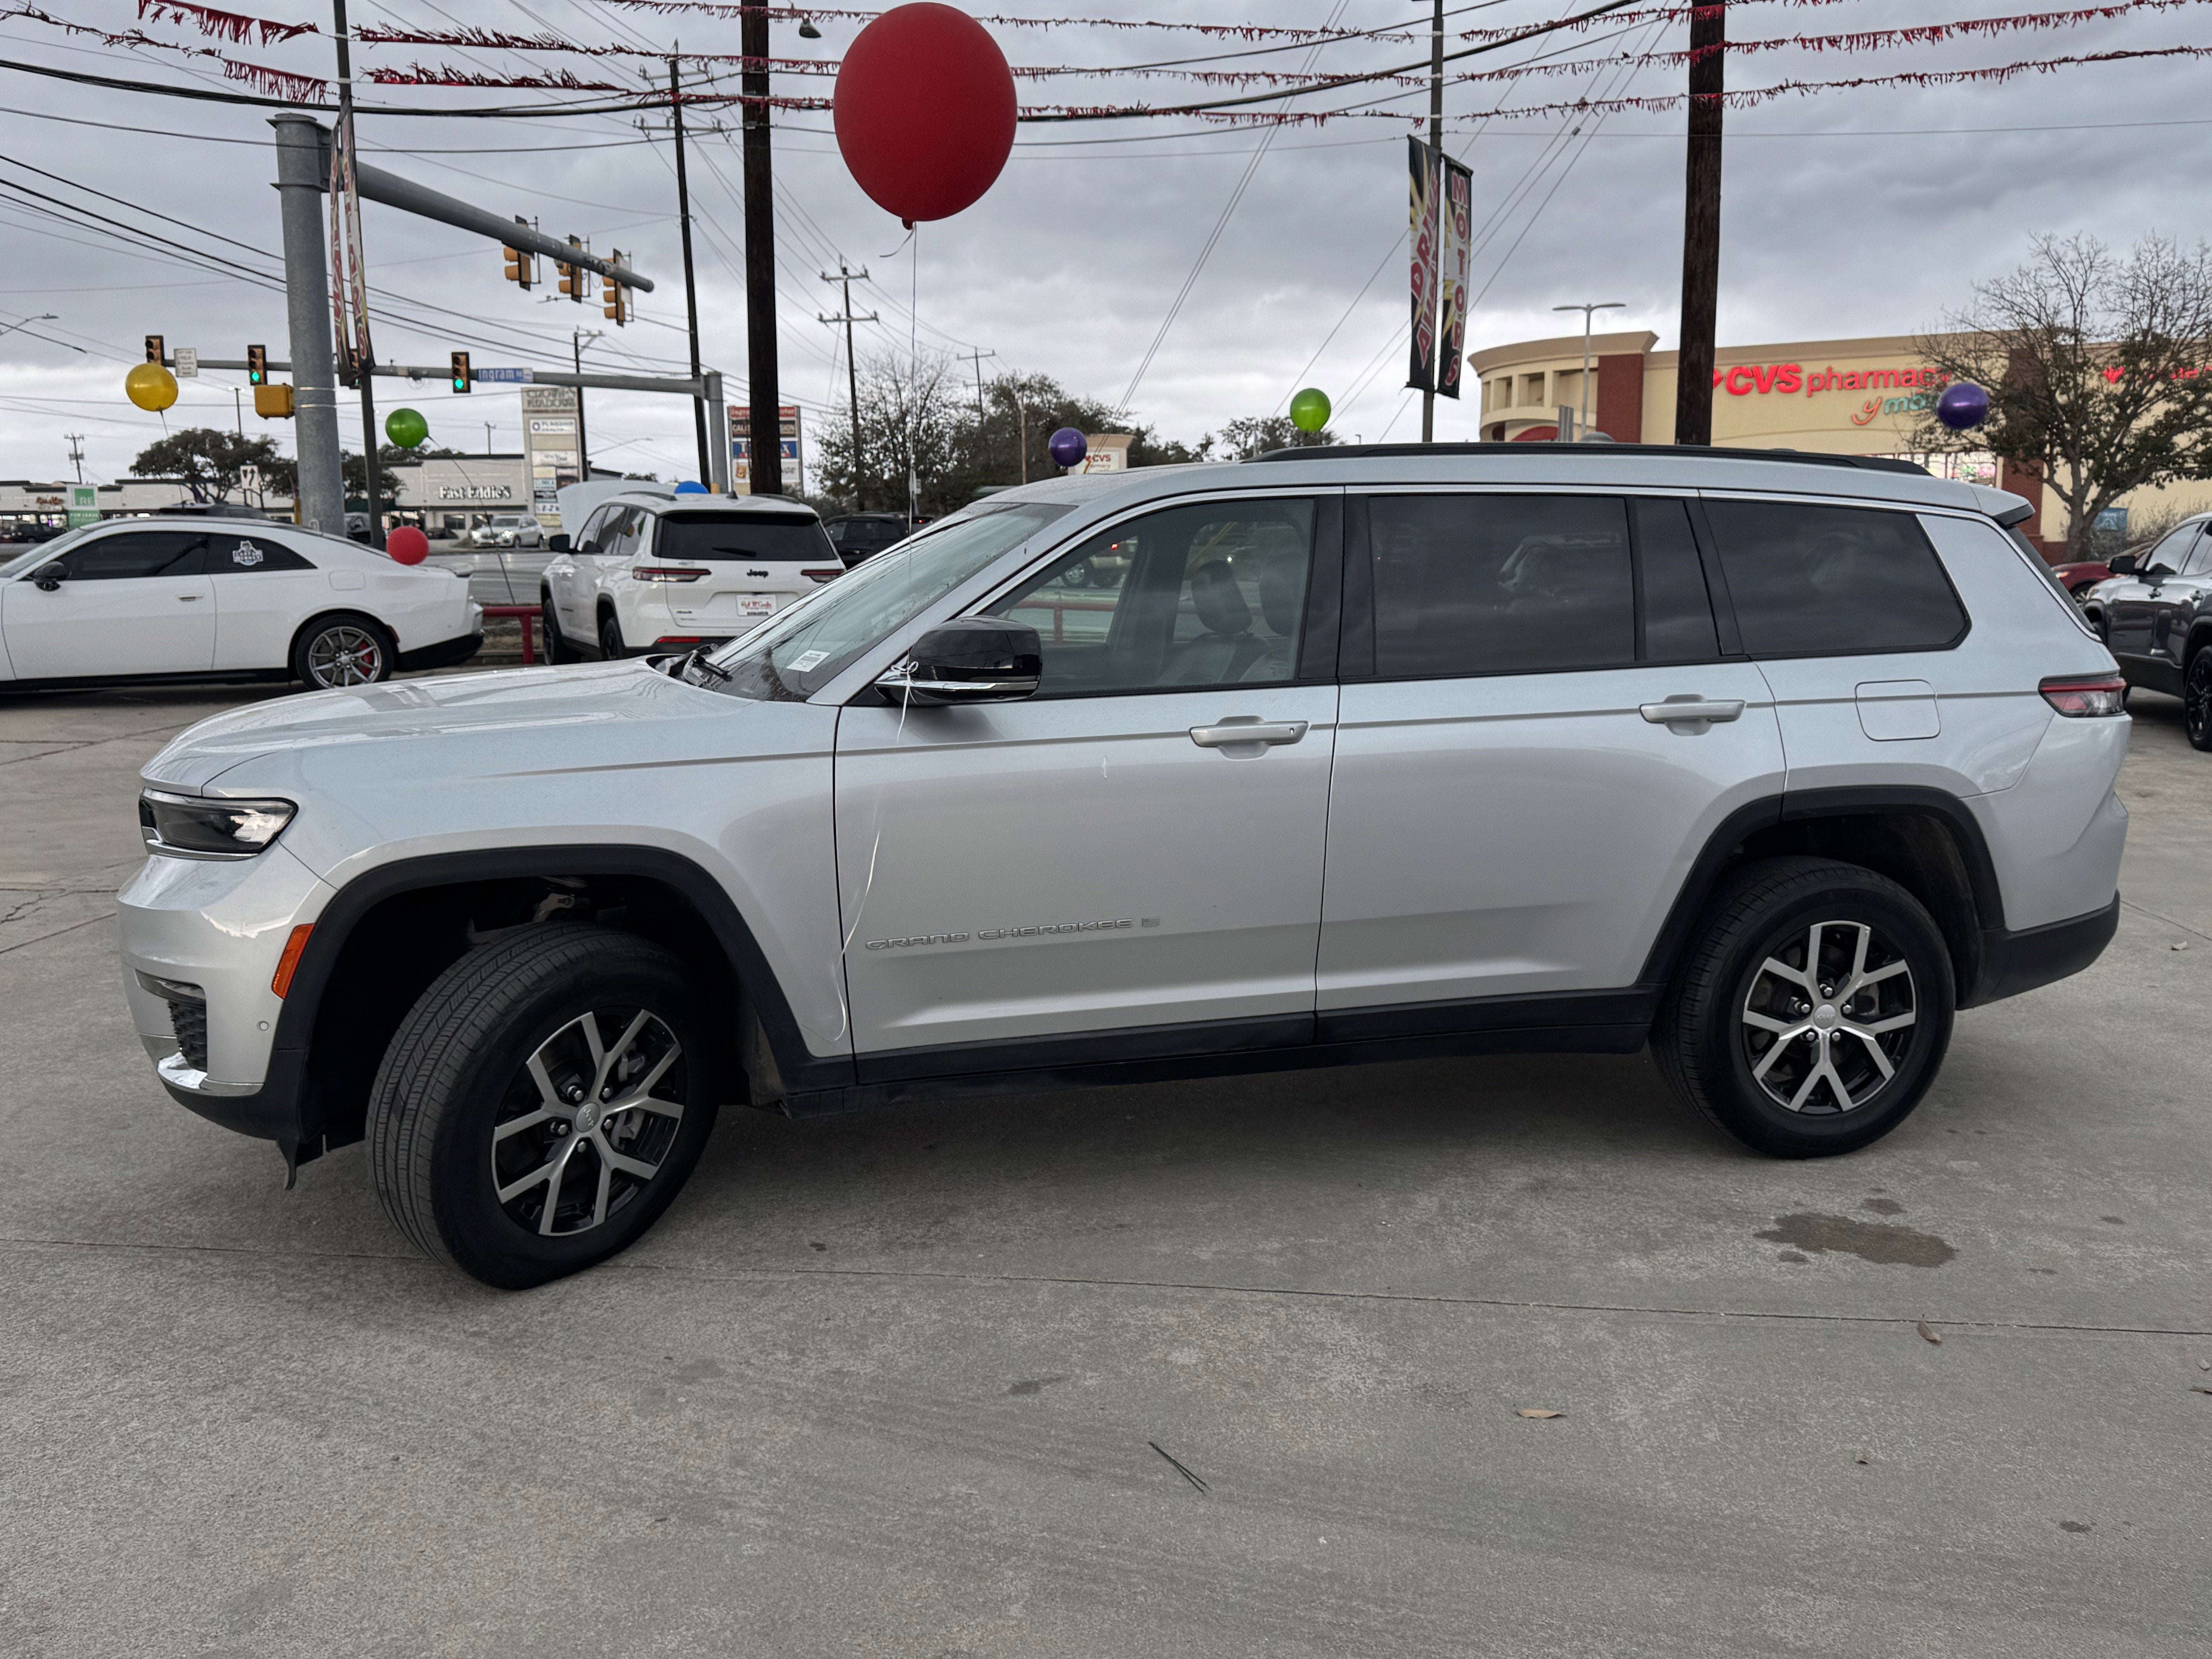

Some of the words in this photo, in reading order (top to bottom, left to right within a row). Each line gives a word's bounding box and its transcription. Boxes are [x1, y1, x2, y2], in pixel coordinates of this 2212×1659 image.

[1445, 172, 1467, 386] MOTORS
[478, 369, 514, 382] Ingram
[1725, 364, 1802, 396] CVS
[1853, 397, 1881, 425] y
[1884, 389, 1927, 415] má
[1093, 454, 1111, 462] CVS
[439, 485, 465, 499] Fast
[467, 485, 511, 499] Eddie's
[747, 569, 769, 578] Jeep
[866, 932, 969, 950] GRAND
[979, 918, 1133, 940] CHEROKEE
